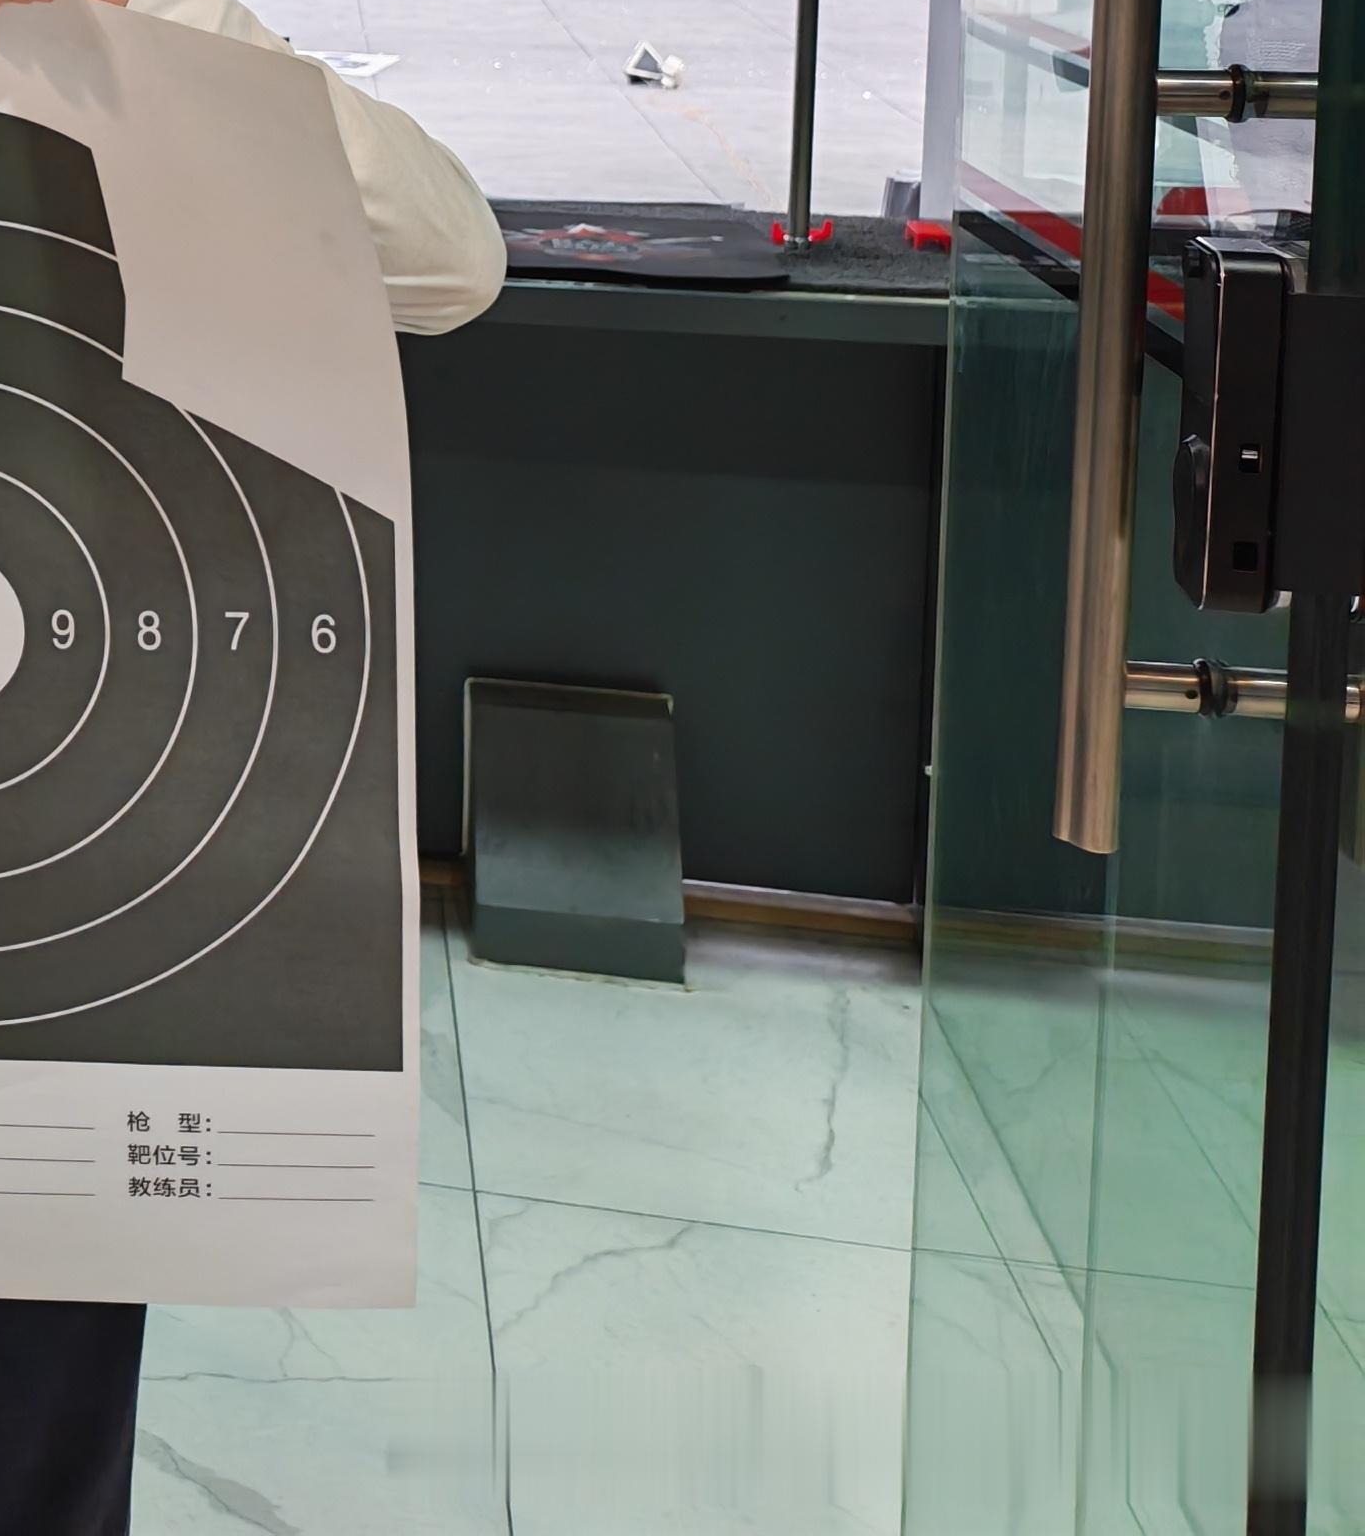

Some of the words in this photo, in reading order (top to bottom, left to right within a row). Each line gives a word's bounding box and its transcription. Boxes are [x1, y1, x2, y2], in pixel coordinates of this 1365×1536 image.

[51, 609, 75, 650] 9
[137, 611, 163, 651] 8
[224, 612, 251, 651] 7
[311, 614, 337, 654] 6
[127, 1144, 212, 1166] 靶位号：
[128, 1176, 213, 1199] 教练员：
